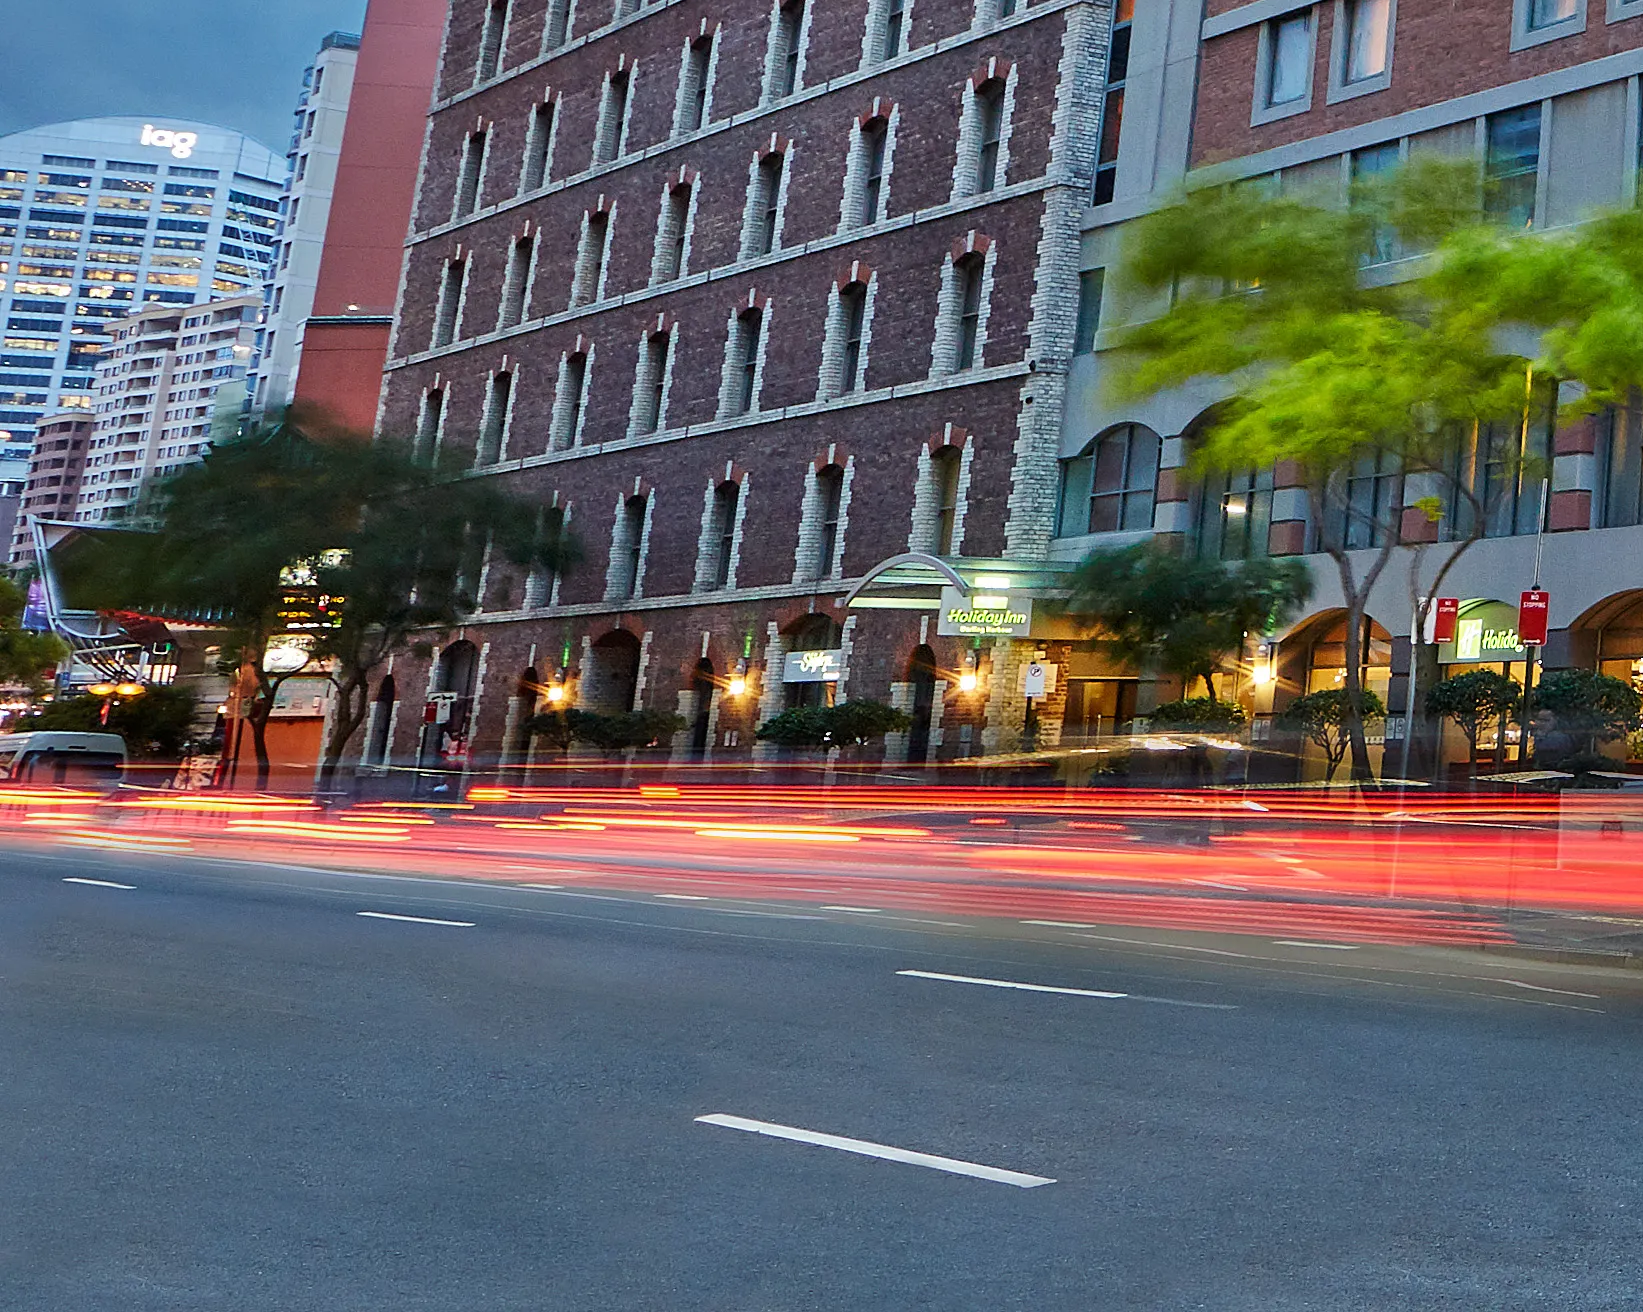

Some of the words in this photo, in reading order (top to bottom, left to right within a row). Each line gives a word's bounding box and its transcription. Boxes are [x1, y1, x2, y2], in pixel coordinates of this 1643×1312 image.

[141, 124, 198, 158] iag
[947, 608, 1004, 627] Holiday
[1004, 610, 1027, 624] Inn
